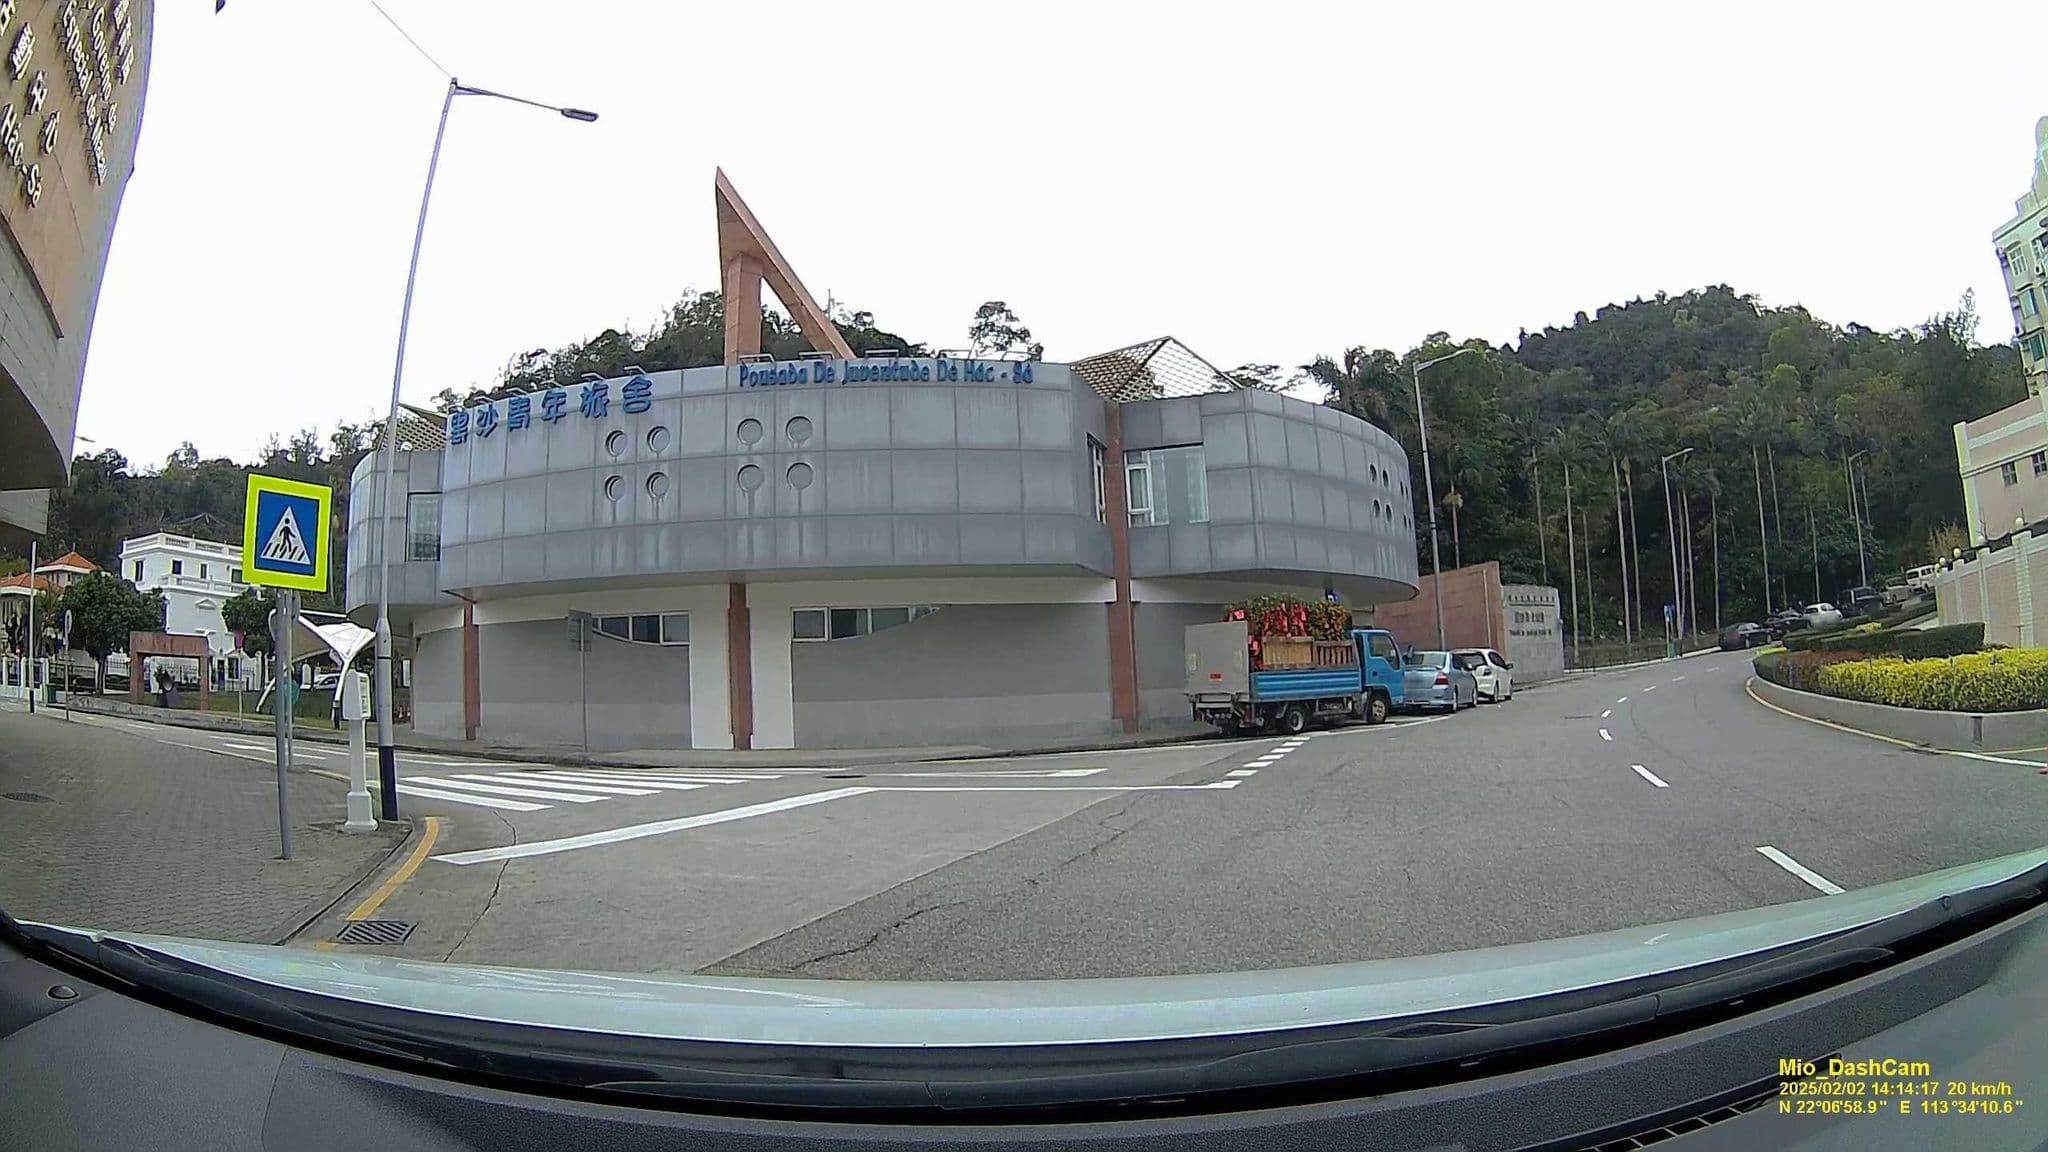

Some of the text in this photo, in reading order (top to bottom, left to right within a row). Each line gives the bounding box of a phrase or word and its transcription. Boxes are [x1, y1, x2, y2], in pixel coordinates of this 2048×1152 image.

[739, 361, 808, 387] Pousada
[814, 361, 835, 383] De
[841, 359, 930, 385] Juventude
[937, 359, 958, 382] De
[449, 375, 653, 445] 黑沙青年旅舍
